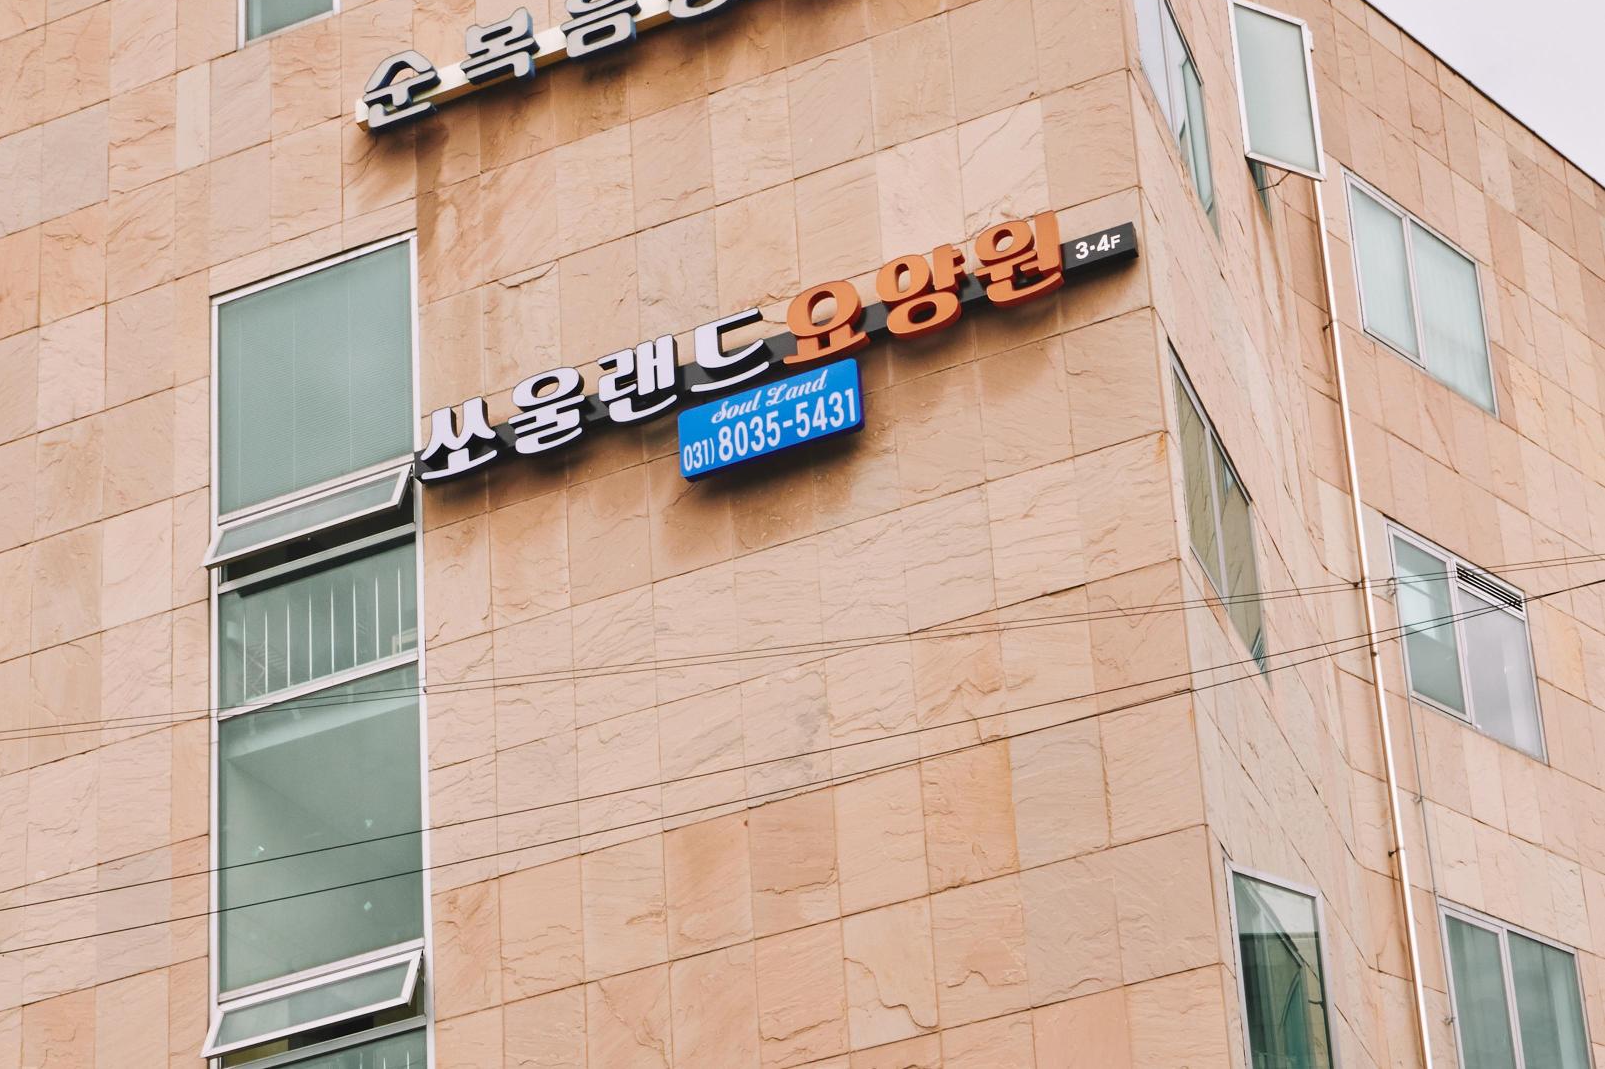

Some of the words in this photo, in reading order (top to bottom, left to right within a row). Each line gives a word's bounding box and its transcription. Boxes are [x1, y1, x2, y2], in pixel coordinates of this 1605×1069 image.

[419, 308, 770, 482] 쏘울랜드
[783, 211, 1062, 366] 요양원
[711, 390, 761, 424] Soul
[765, 369, 829, 407] Land
